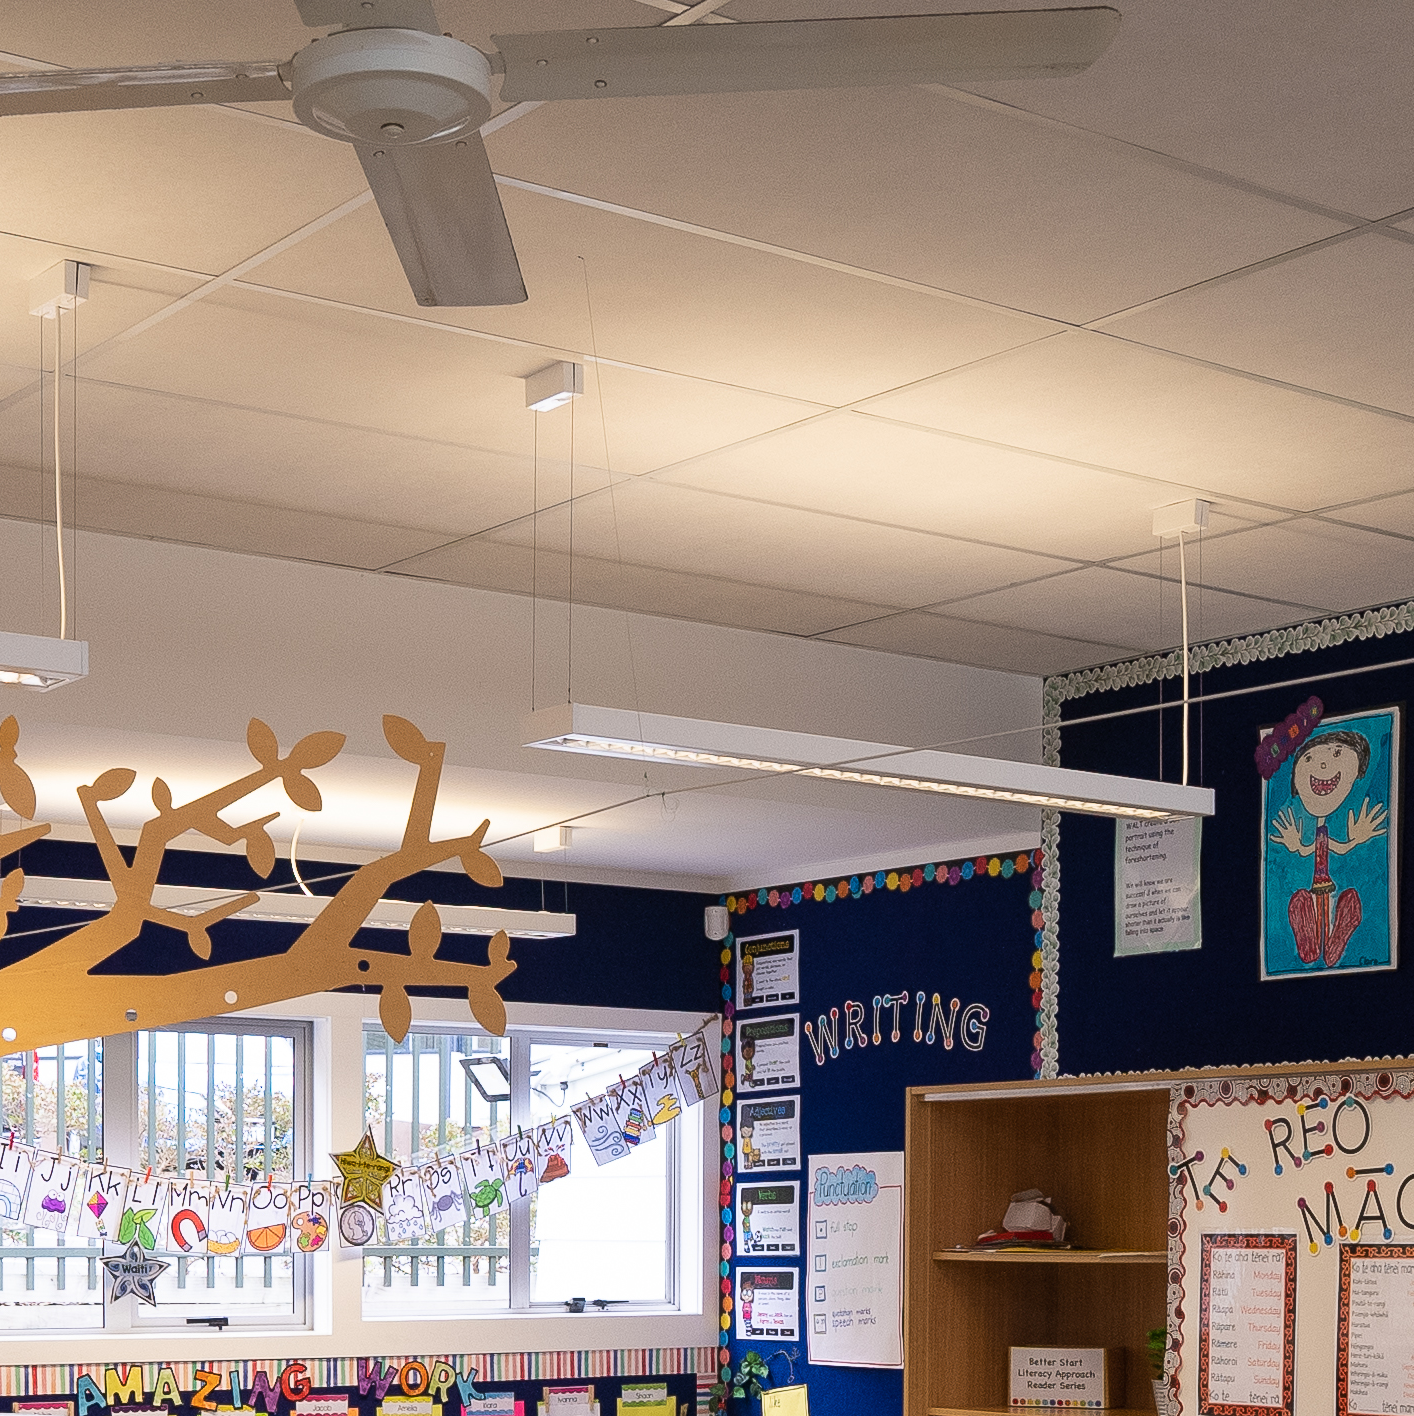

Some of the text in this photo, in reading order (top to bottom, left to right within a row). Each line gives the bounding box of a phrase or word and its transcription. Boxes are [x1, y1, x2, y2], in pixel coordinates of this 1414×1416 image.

[804, 990, 990, 1065] WRITING
[1169, 1098, 1371, 1212] TE REO
[818, 1172, 874, 1199] Punctuation
[831, 1220, 858, 1236] full stop
[832, 1253, 889, 1269] exclamation mark
[1240, 1304, 1282, 1316] Wednesday
[1248, 1323, 1281, 1334] Thursday
[1029, 1358, 1083, 1367] Better Start
[1018, 1369, 1096, 1380] Literacy Approach
[76, 1358, 487, 1416] AMAZING WORK
[1027, 1381, 1085, 1390] Reader Series
[312, 1403, 332, 1412] Jacob
